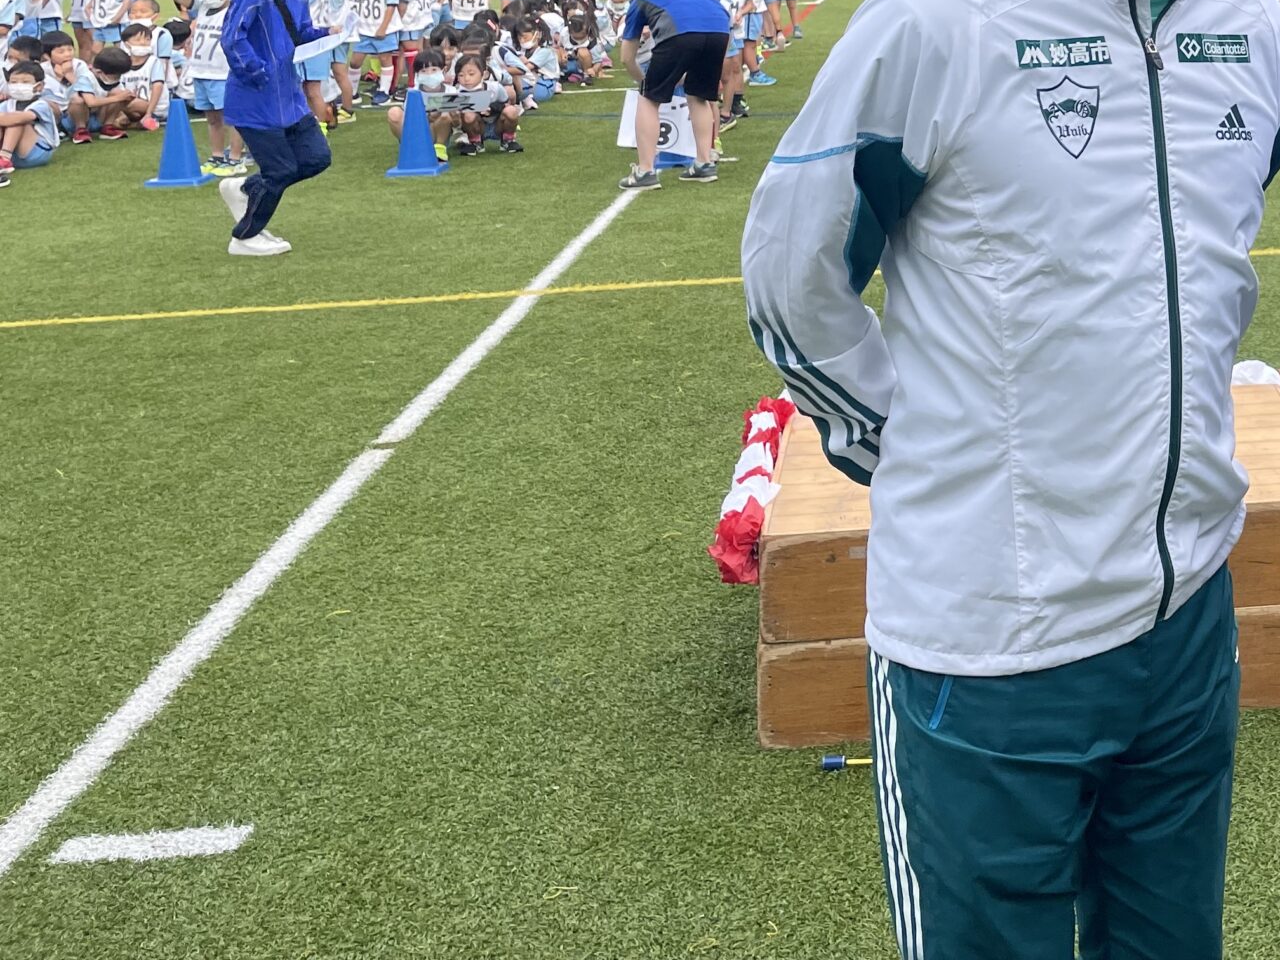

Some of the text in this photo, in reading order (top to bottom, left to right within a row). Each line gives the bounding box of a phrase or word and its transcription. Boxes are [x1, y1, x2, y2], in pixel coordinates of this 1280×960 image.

[1049, 40, 1109, 65] 妙高市
[1204, 42, 1246, 54] Colantotte
[1215, 127, 1252, 141] adidas
